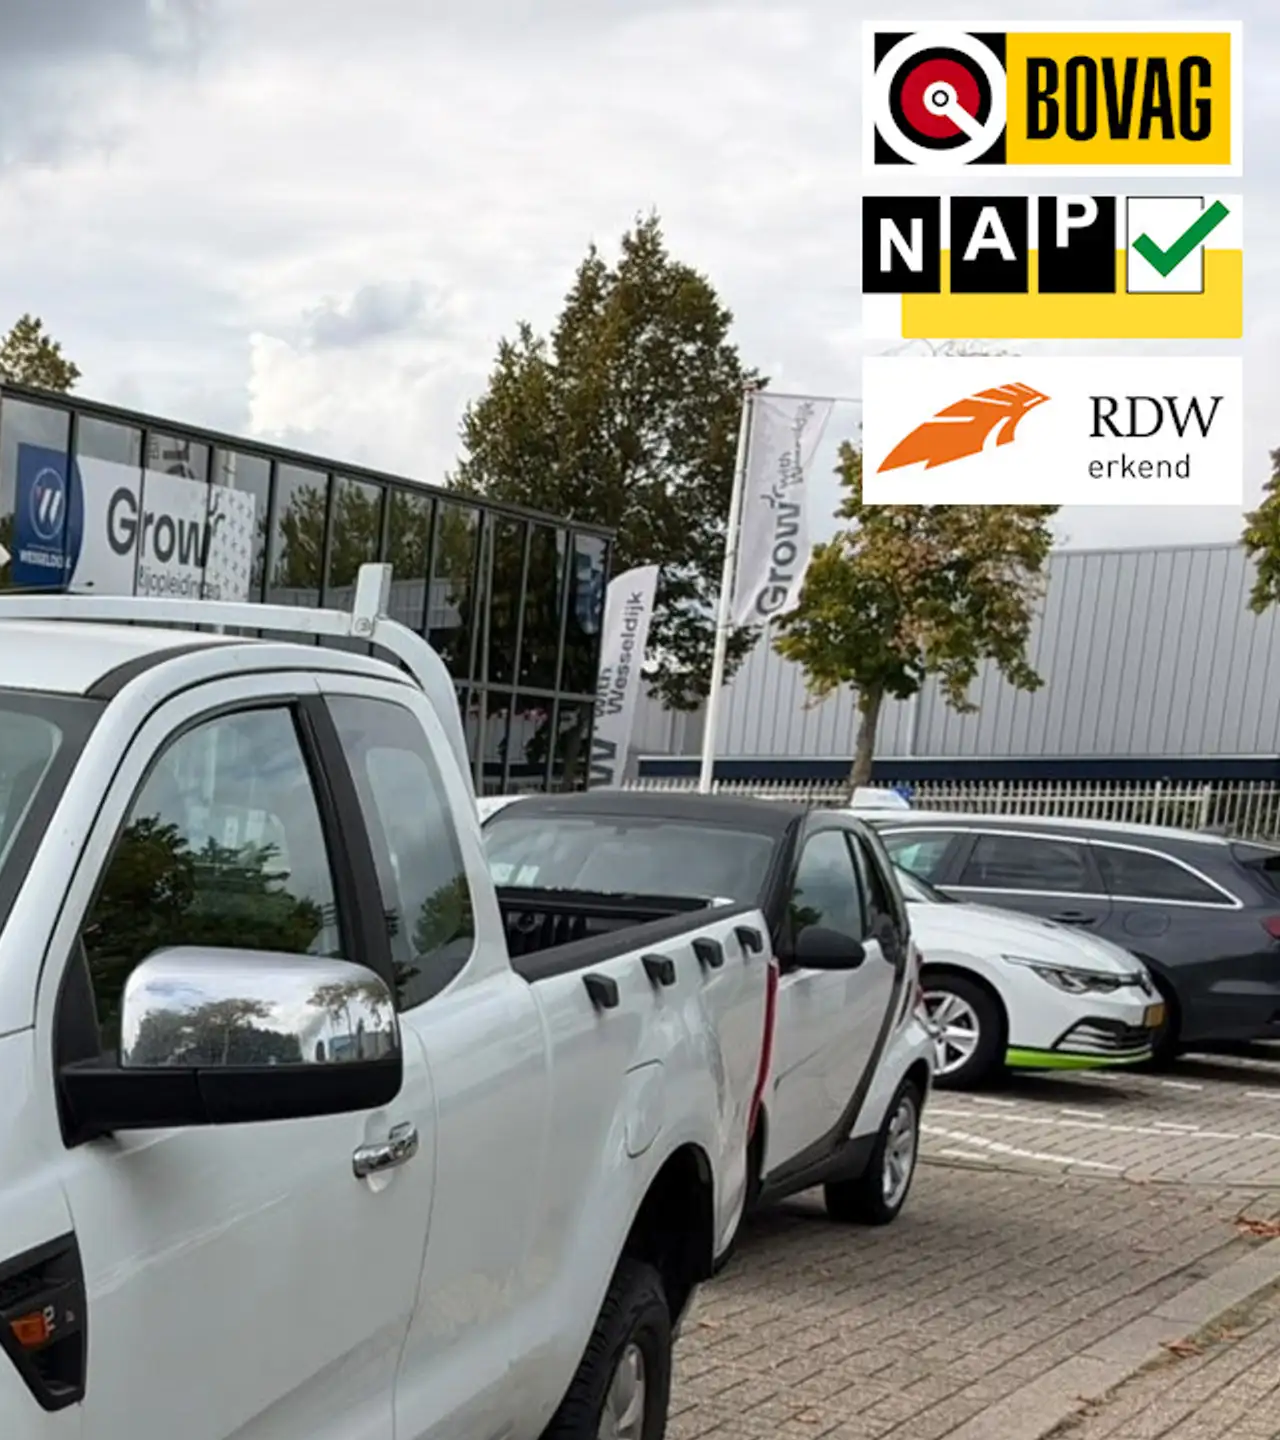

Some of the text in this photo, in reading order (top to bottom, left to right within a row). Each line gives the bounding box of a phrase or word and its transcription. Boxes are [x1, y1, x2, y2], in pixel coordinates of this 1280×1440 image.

[106, 486, 211, 568] Grow
[755, 501, 802, 616] Grow
[606, 591, 645, 715] Wesseldijk
